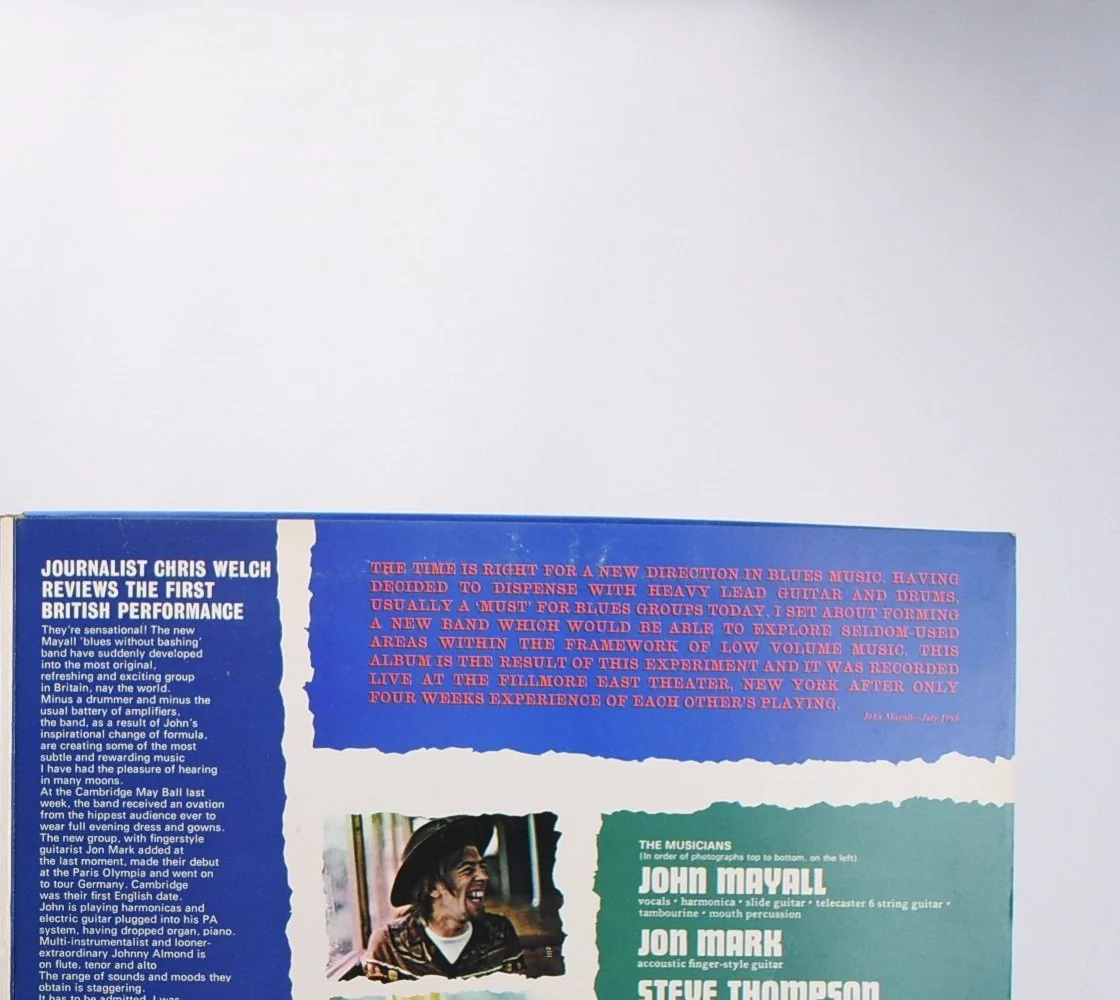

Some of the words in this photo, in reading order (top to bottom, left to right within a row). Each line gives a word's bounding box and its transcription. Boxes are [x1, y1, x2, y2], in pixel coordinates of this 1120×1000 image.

[41, 560, 148, 577] JOURNALIST
[154, 560, 206, 577] CHRIS
[213, 561, 271, 578] WELCH
[370, 562, 406, 575] THE
[412, 563, 456, 576] TIME
[460, 564, 478, 576] IS
[479, 564, 538, 577] RIGHT
[543, 565, 577, 578] FOR
[579, 566, 594, 578] A
[596, 566, 639, 579] NEW
[646, 567, 740, 581] DIRECTION
[743, 569, 762, 581] IN
[764, 569, 823, 582] BLUES
[891, 571, 960, 584] HAVING
[42, 581, 118, 598] REVIEWS
[126, 581, 158, 598] THE
[166, 582, 214, 598] FIRST
[42, 602, 110, 619] BRITISH
[118, 603, 243, 620] PERFORMANCE
[41, 625, 80, 637] They're
[83, 625, 147, 634] sensational!
[150, 625, 170, 635] The
[41, 637, 76, 648] Mayall
[113, 637, 154, 646] without
[639, 840, 662, 850] THE
[664, 840, 732, 850] MUSICIANS
[639, 867, 707, 894] JOHN
[717, 868, 827, 895] MAYALL
[638, 929, 687, 956] JON
[697, 930, 782, 957] MARK
[637, 958, 686, 968] accoustic
[688, 958, 749, 971] finger-style
[751, 959, 784, 971] guitar
